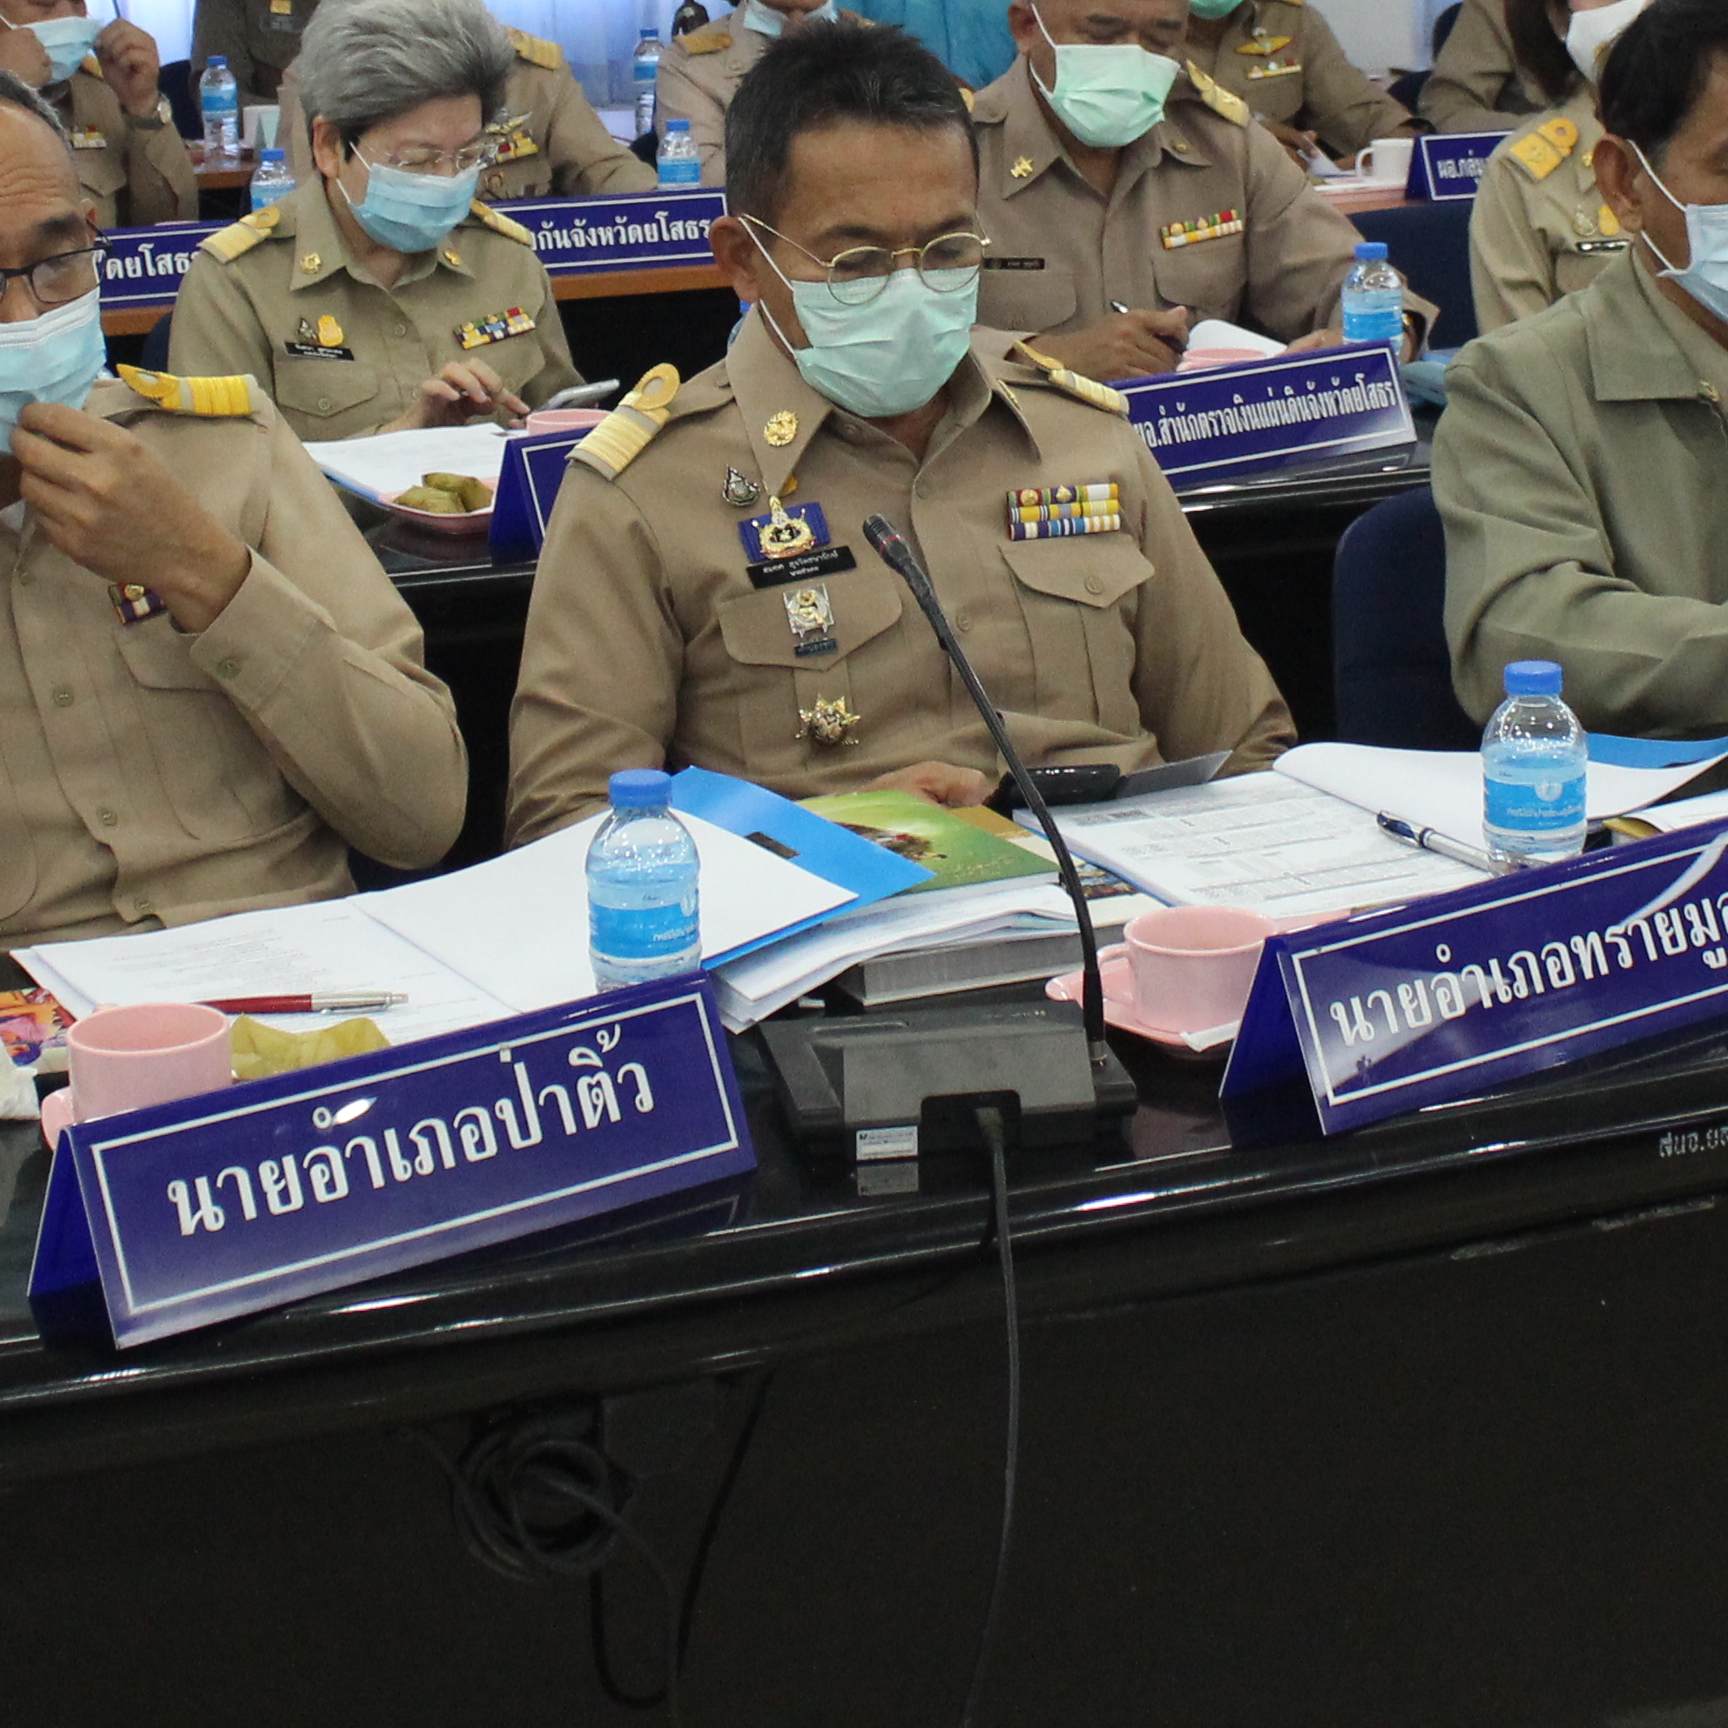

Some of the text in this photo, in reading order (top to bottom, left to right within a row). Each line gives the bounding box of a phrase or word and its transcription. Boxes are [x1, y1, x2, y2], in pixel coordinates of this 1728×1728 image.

[167, 1024, 655, 1237] นายอำเภอป่าติ้ว
